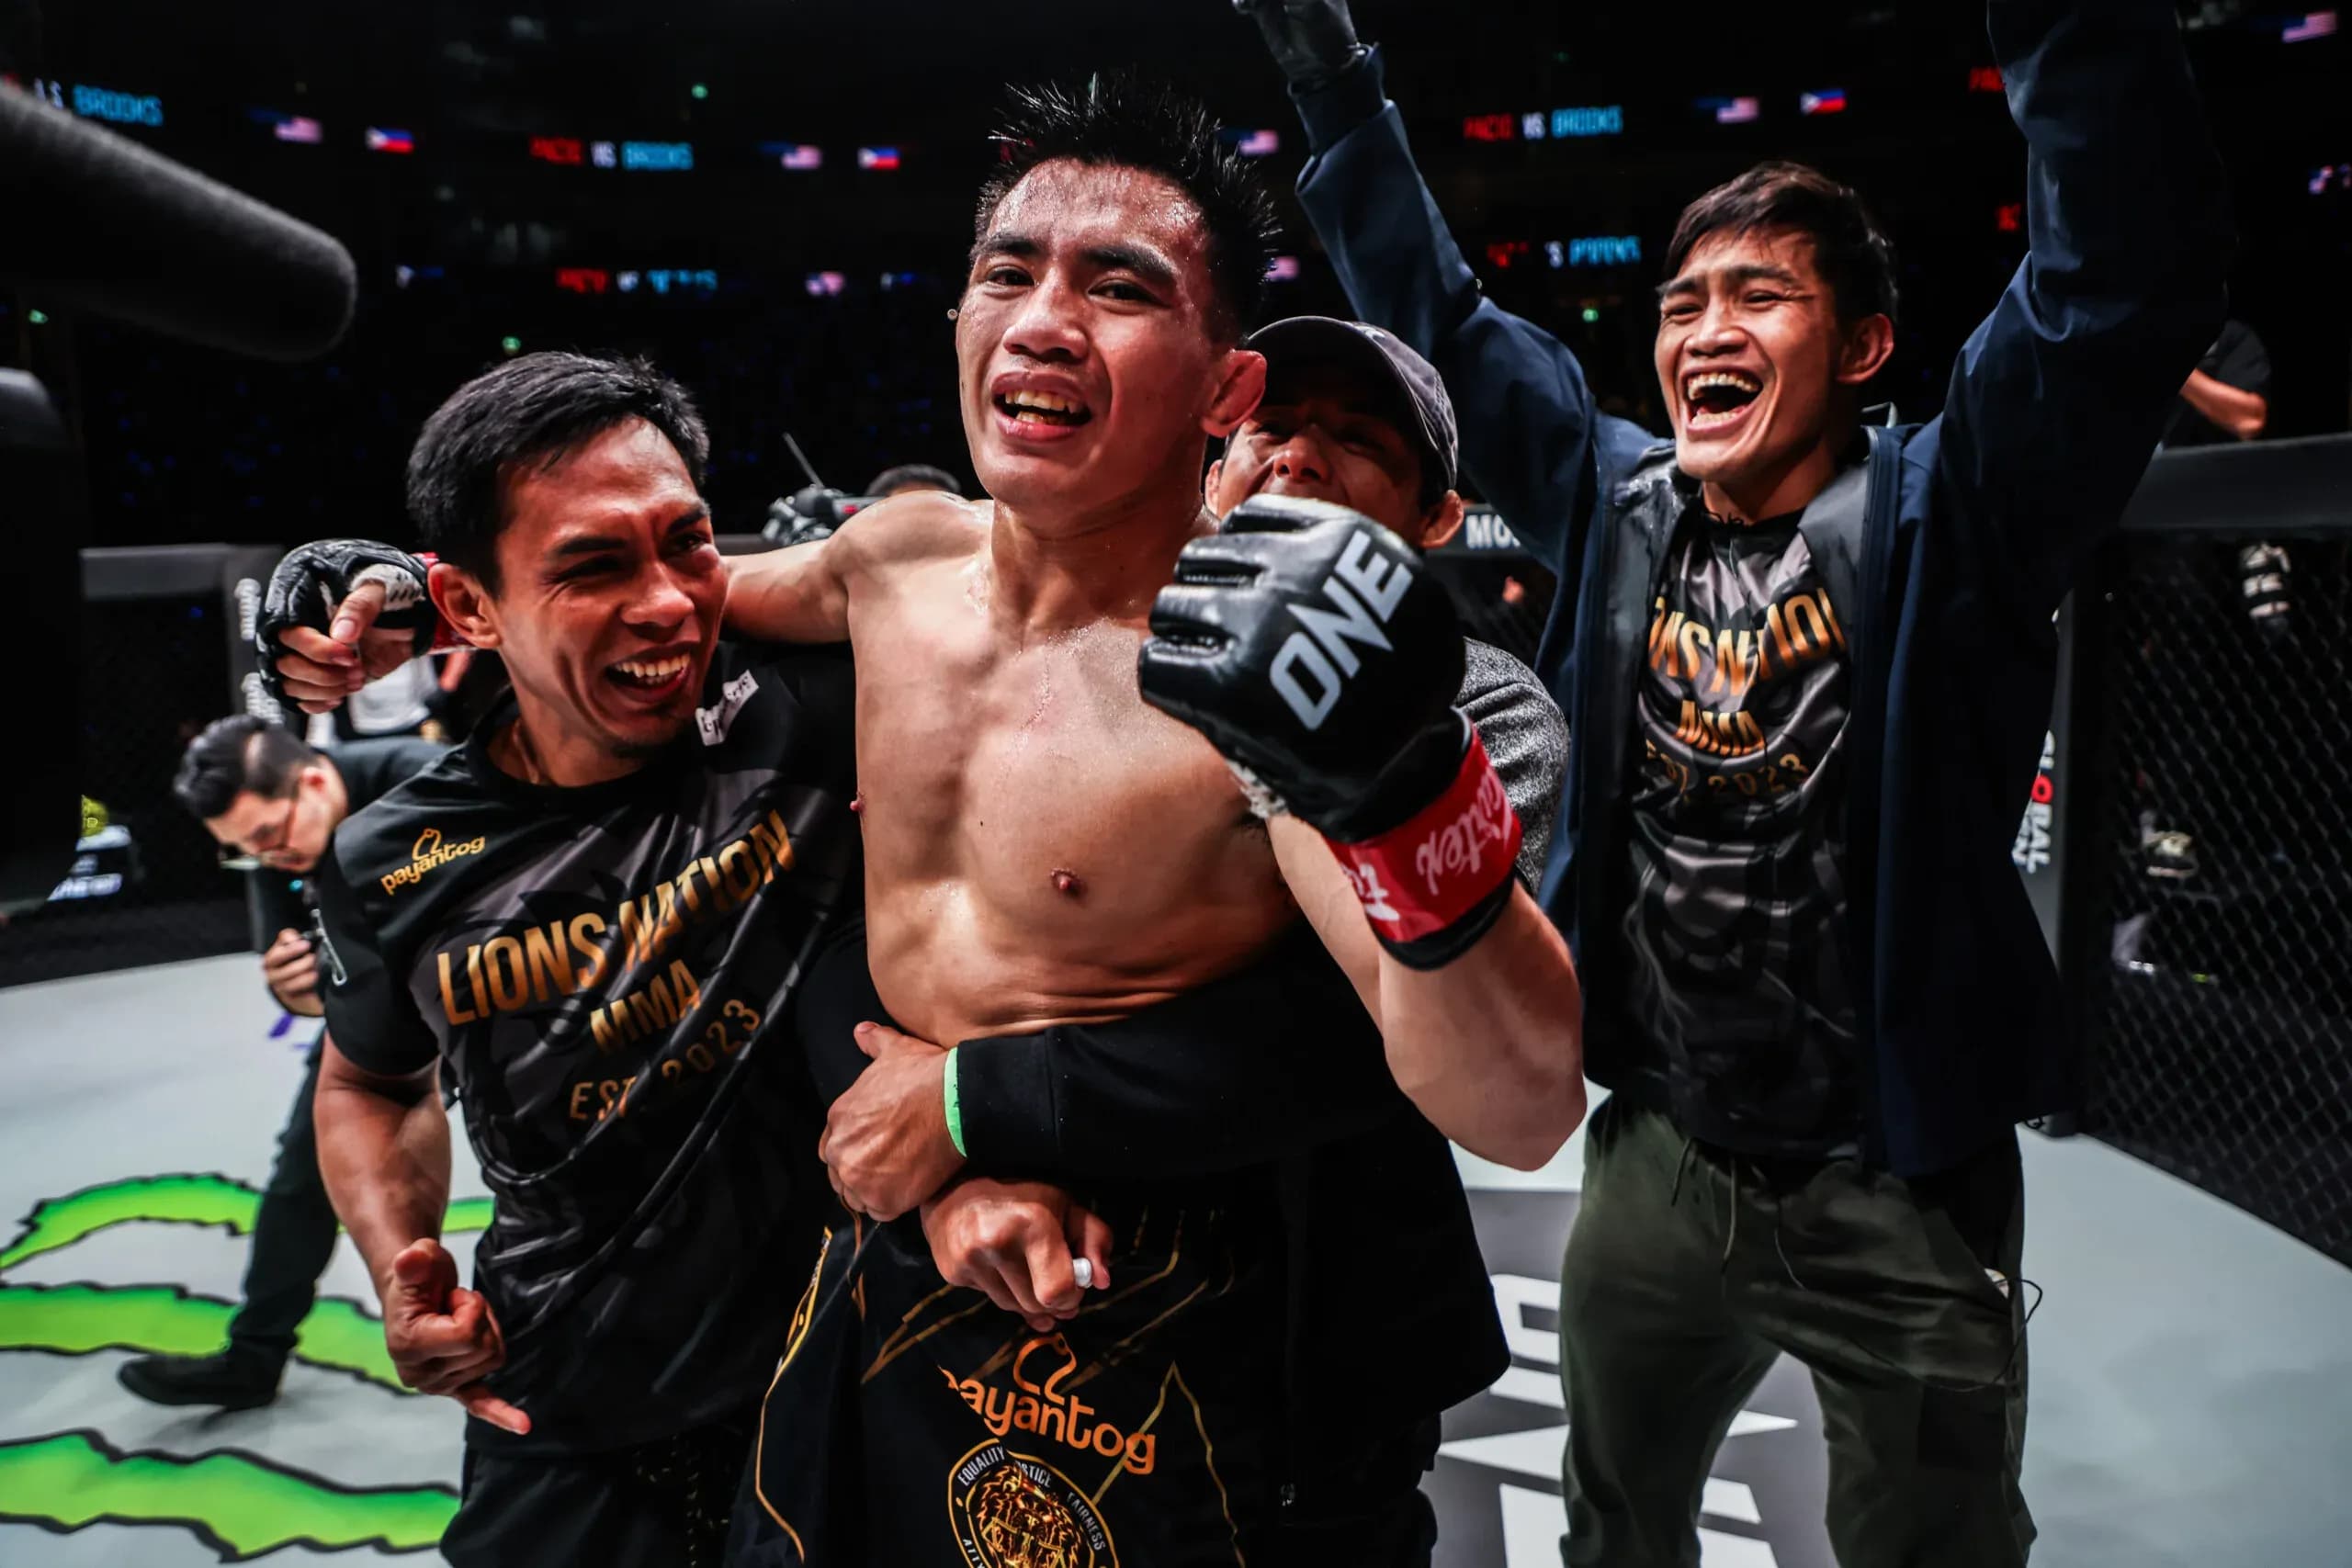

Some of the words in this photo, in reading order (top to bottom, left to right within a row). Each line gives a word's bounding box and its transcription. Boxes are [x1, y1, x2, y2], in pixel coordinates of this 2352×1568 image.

[1465, 514, 1521, 548] MO
[1270, 529, 1414, 732] ONE
[380, 835, 486, 897] payantog
[436, 912, 607, 1026] LIONS
[618, 808, 796, 974] NATION
[590, 959, 701, 1053] MMA
[937, 1365, 1156, 1475] ayantog
[957, 1446, 1005, 1486] EQUALITY
[1066, 1492, 1107, 1551] FAIRNESS
